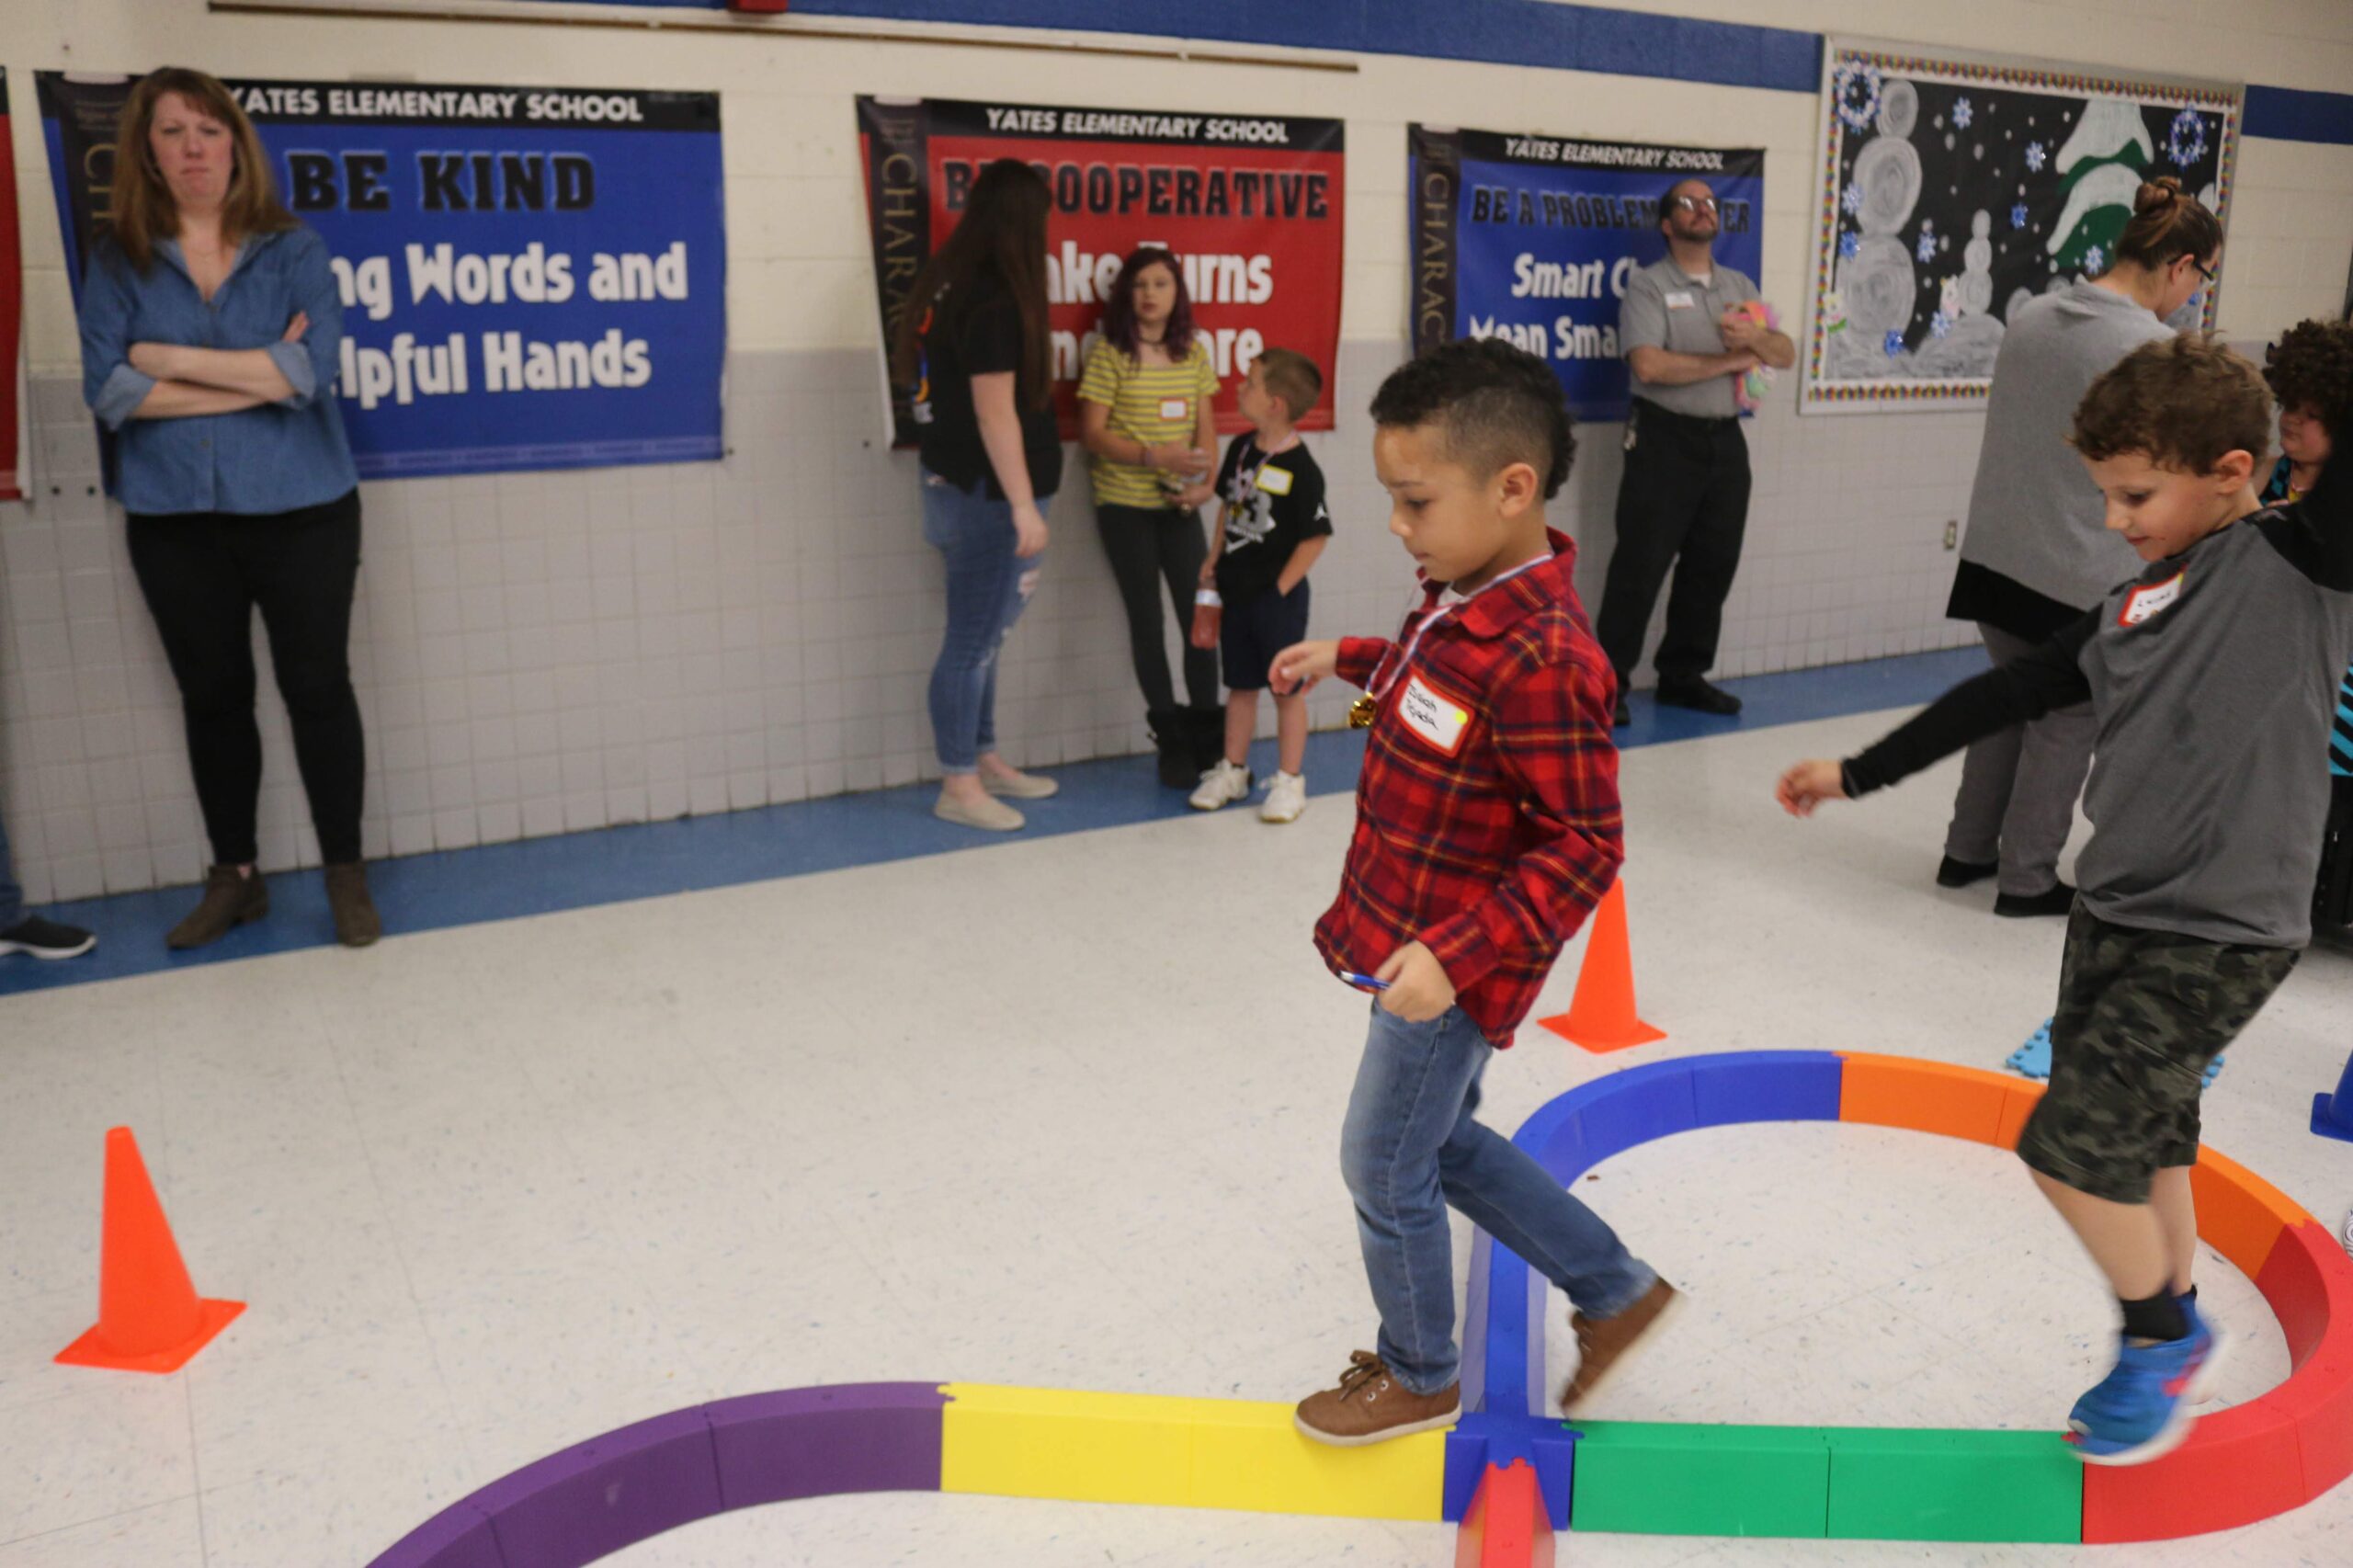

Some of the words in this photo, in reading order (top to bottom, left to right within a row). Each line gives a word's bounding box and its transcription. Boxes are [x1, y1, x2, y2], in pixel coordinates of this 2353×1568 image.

[328, 89, 517, 119] ELEMENTARY
[526, 94, 644, 121] SCHOOL
[986, 108, 1057, 132] YATES
[1062, 112, 1201, 137] ELEMENTARY
[1204, 119, 1289, 142] SCHOOL
[1506, 138, 1560, 160] YATES
[1562, 142, 1665, 166] ELEMENTARY
[1665, 150, 1723, 170] SCHOOL
[287, 150, 391, 211] BE
[416, 150, 596, 211] KIND
[1028, 161, 1328, 219] OOPERATIVE
[1472, 185, 1509, 223] BE
[1518, 188, 1535, 226] A
[404, 242, 574, 305] Words
[588, 241, 688, 301] and
[1045, 240, 1123, 304] ake
[1138, 241, 1273, 304] urns
[1420, 172, 1449, 345] CHARAC
[1511, 252, 1605, 299] Smart
[1554, 315, 1620, 359] Sma
[338, 332, 468, 409] lpful
[482, 328, 652, 392] Hands
